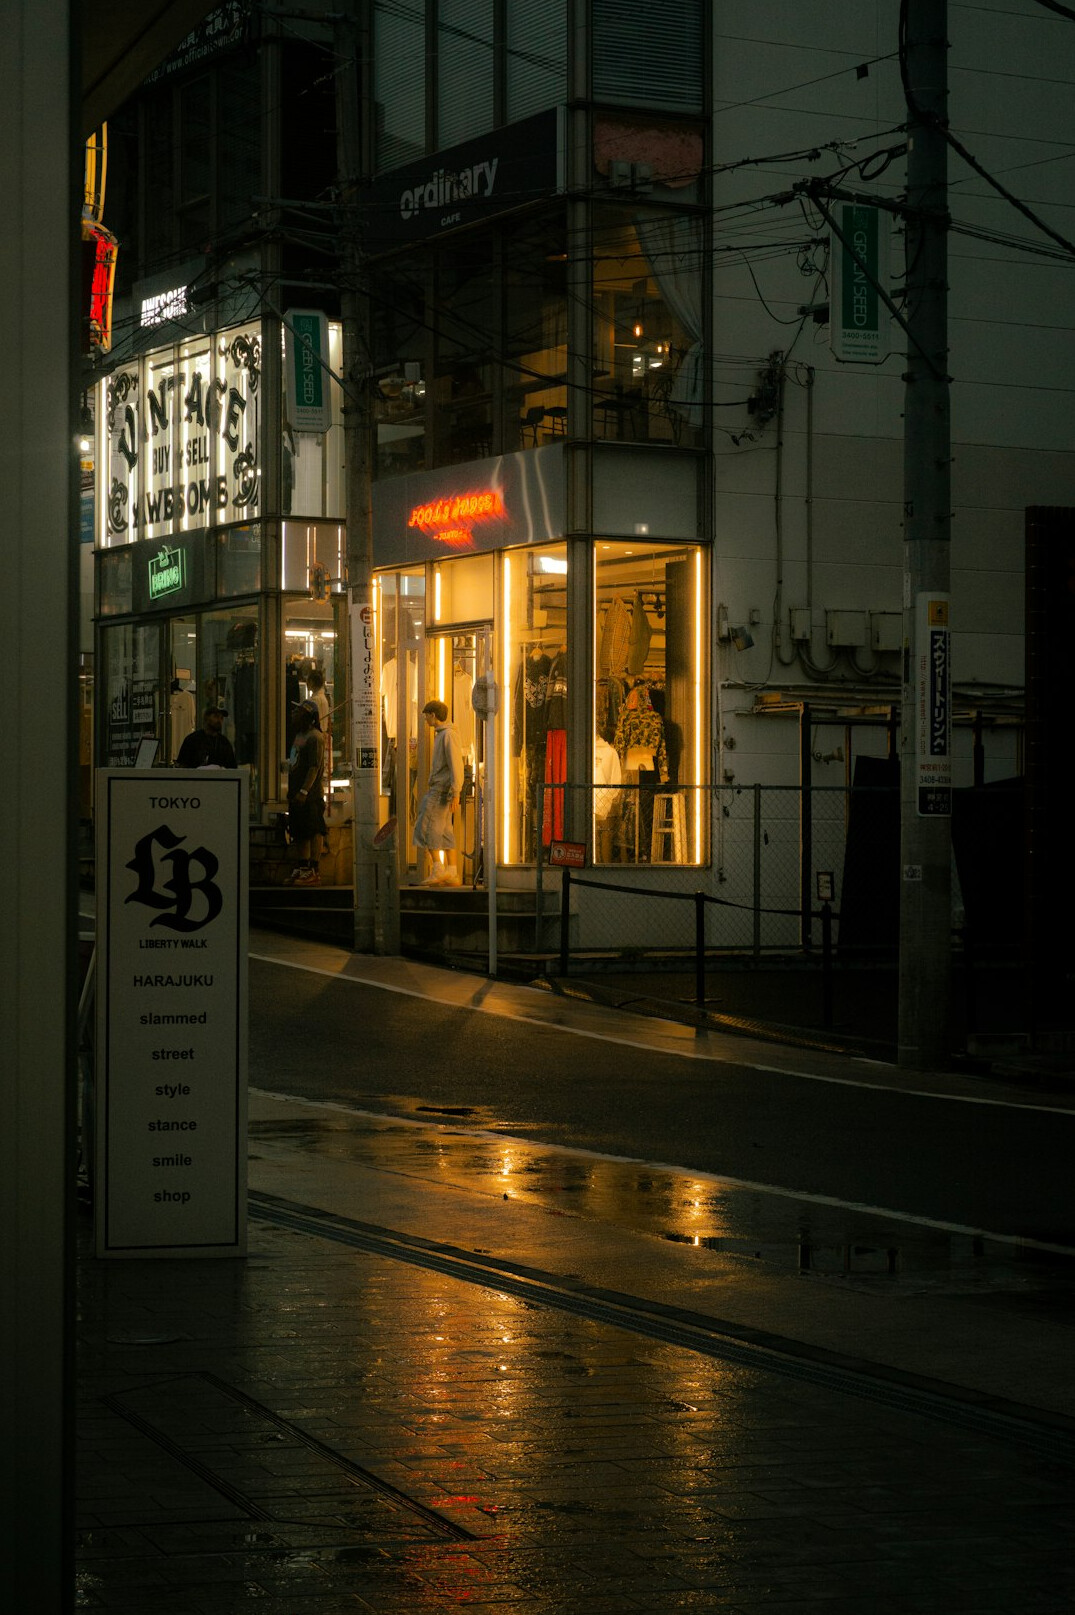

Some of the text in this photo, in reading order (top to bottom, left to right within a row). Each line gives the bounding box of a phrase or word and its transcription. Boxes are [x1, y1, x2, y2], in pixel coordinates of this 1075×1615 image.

[401, 157, 498, 220] ordinary
[853, 286, 867, 326] SEED
[302, 332, 314, 372] GEEN
[303, 373, 315, 404] SEED
[153, 444, 171, 475] BUY
[186, 436, 209, 467] SELL
[149, 797, 201, 809] TOKYO
[139, 939, 208, 949] LIBERTY WALK
[133, 975, 214, 987] HARAJUKU
[139, 1012, 207, 1025] slammed
[152, 1048, 195, 1060] street
[155, 1083, 191, 1099] style
[148, 1119, 197, 1131] stance
[152, 1154, 192, 1167] smile
[154, 1189, 191, 1204] shop
